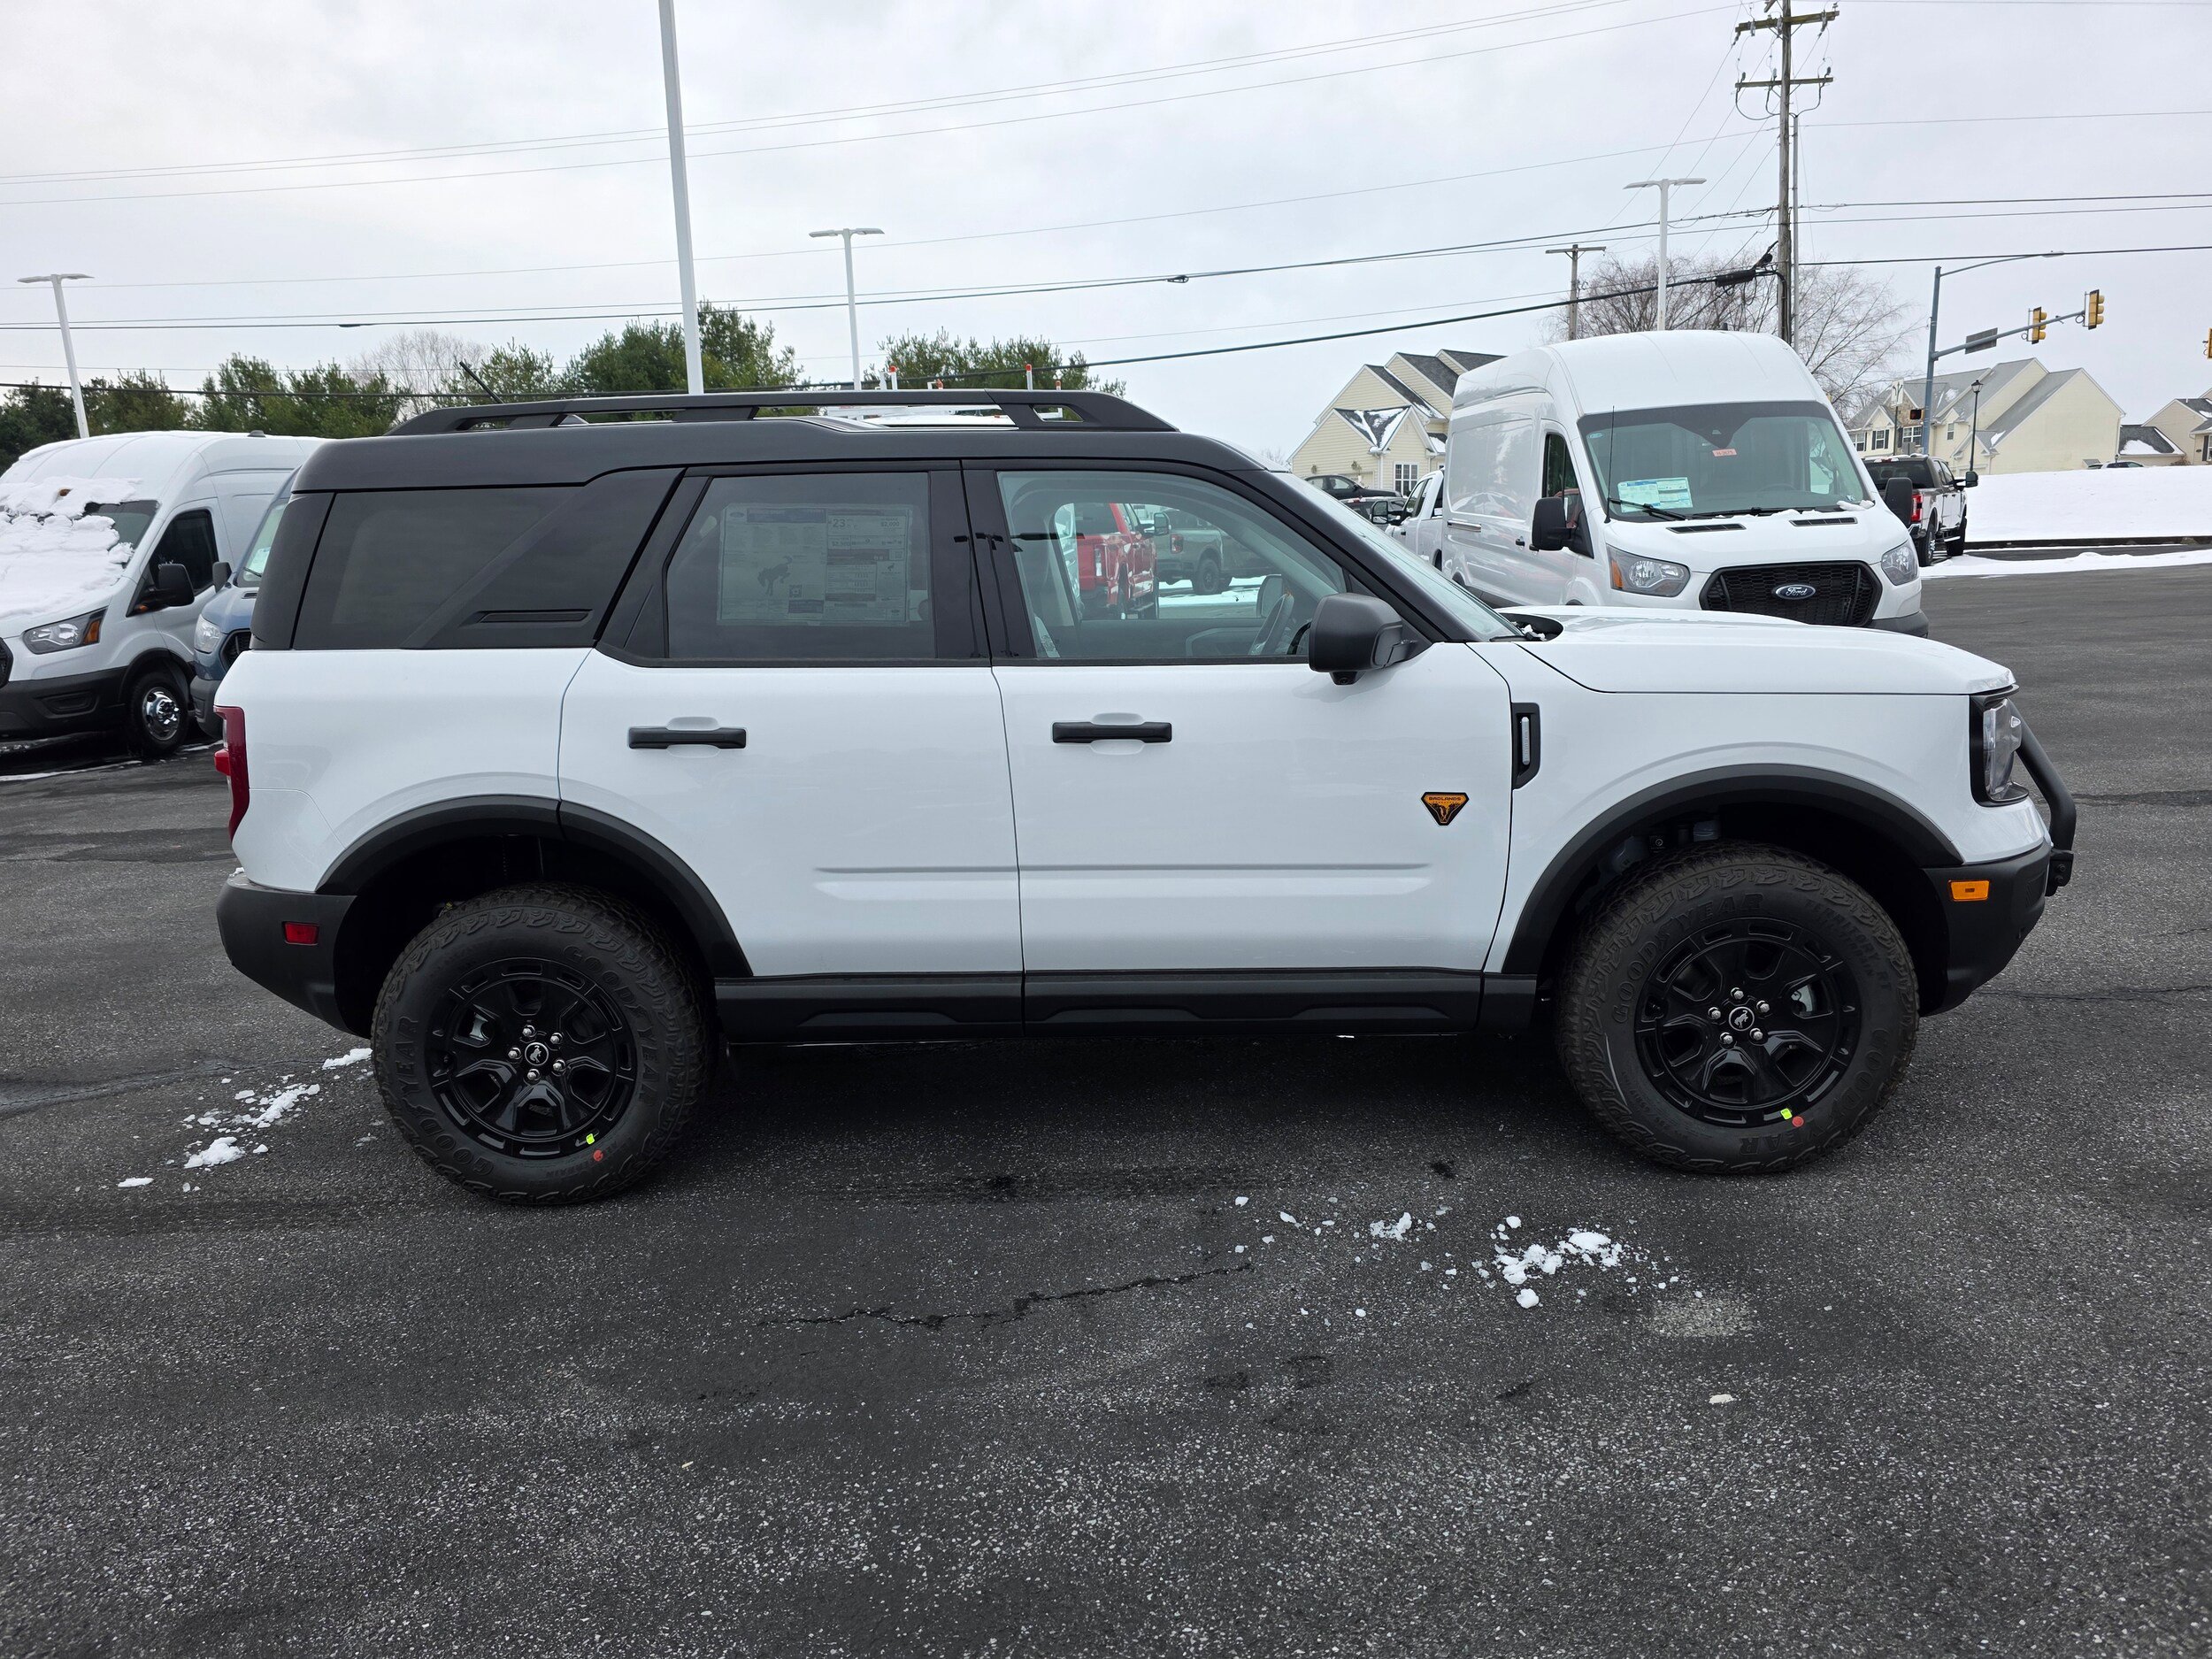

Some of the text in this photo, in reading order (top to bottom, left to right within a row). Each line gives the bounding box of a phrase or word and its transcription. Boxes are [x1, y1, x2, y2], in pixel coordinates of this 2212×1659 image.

[1786, 587, 1808, 596] Ford
[1611, 893, 1763, 1023] GOODYEAR
[563, 945, 663, 1105] GOODYEAR
[395, 1016, 495, 1175] GOODYEAR
[1740, 1027, 1891, 1155] GOODYEAR
